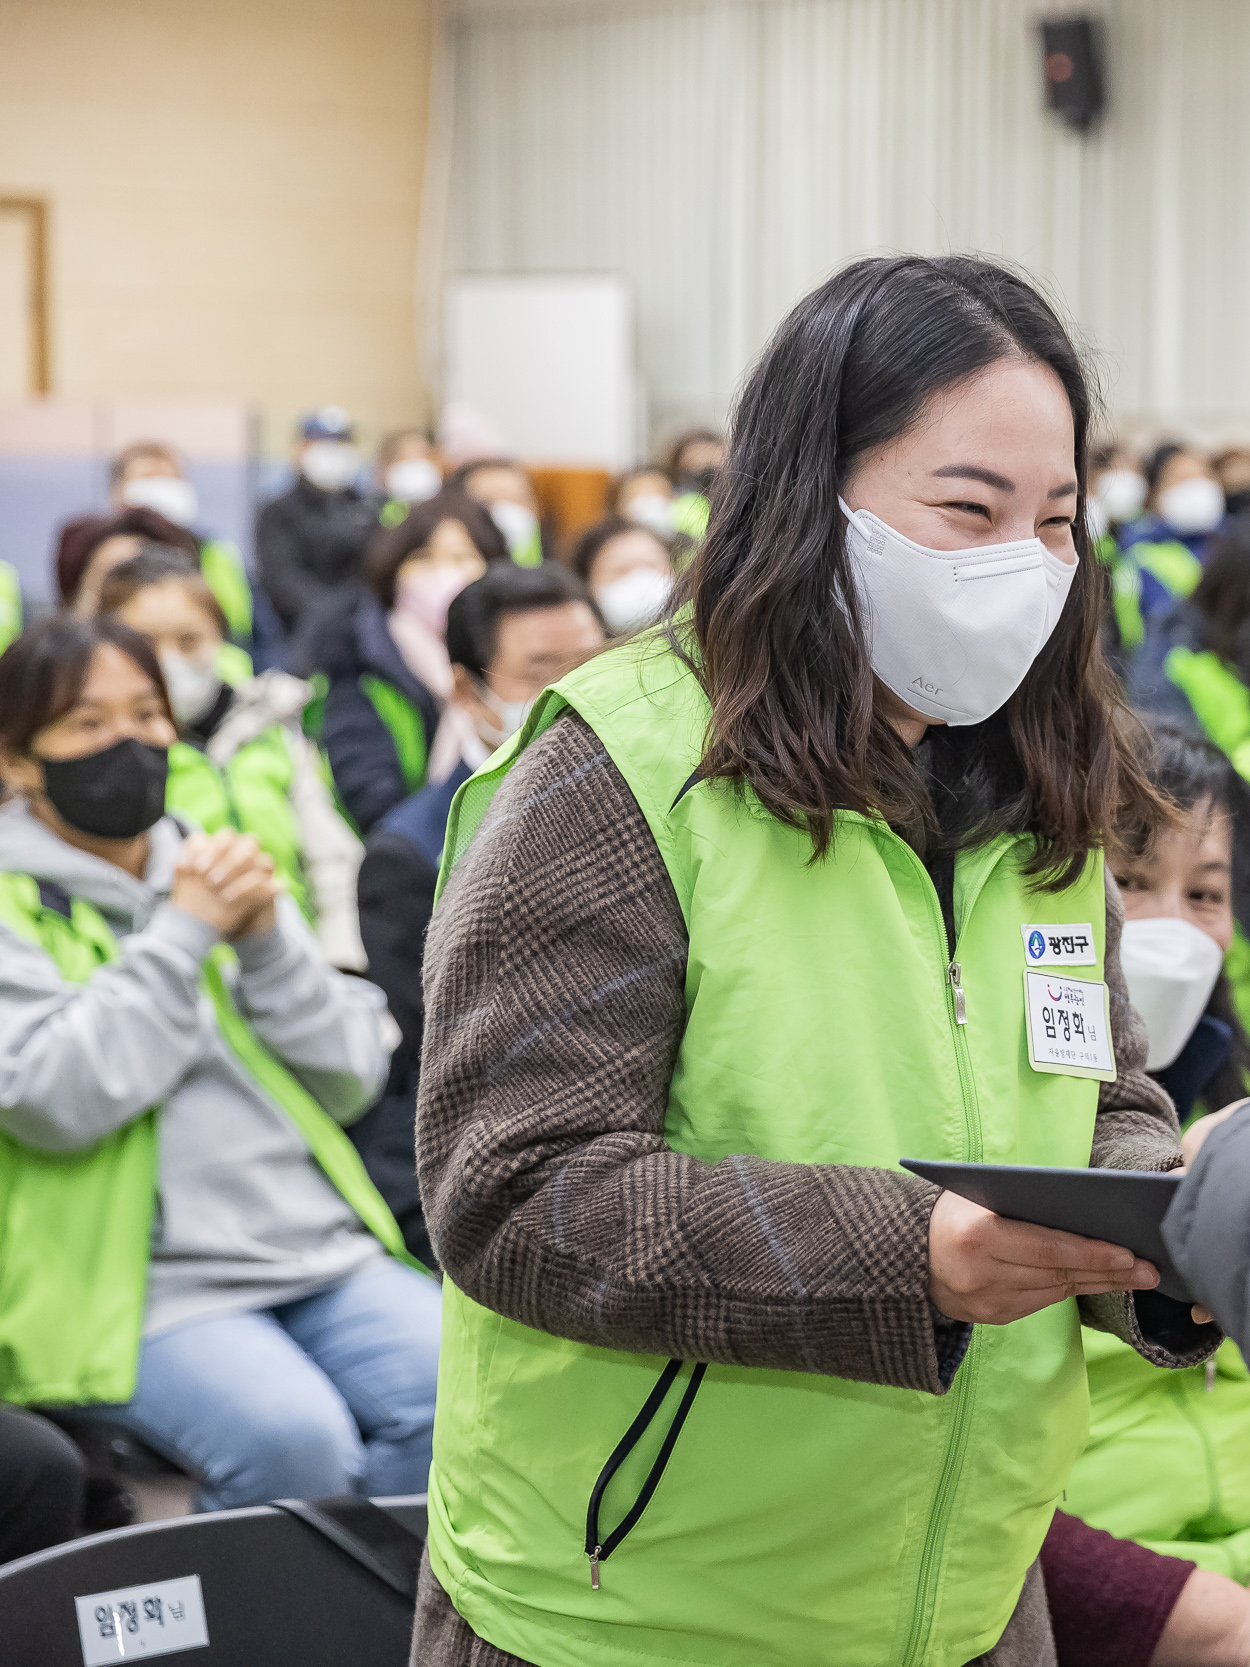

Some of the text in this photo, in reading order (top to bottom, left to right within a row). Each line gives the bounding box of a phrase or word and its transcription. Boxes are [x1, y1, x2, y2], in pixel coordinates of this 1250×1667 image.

[911, 676, 943, 695] Aer
[1048, 935, 1089, 955] 광진구
[1042, 1006, 1097, 1043] 임정화 님
[1048, 1047, 1076, 1060] 자율방재단
[94, 1594, 164, 1638] 임정화
